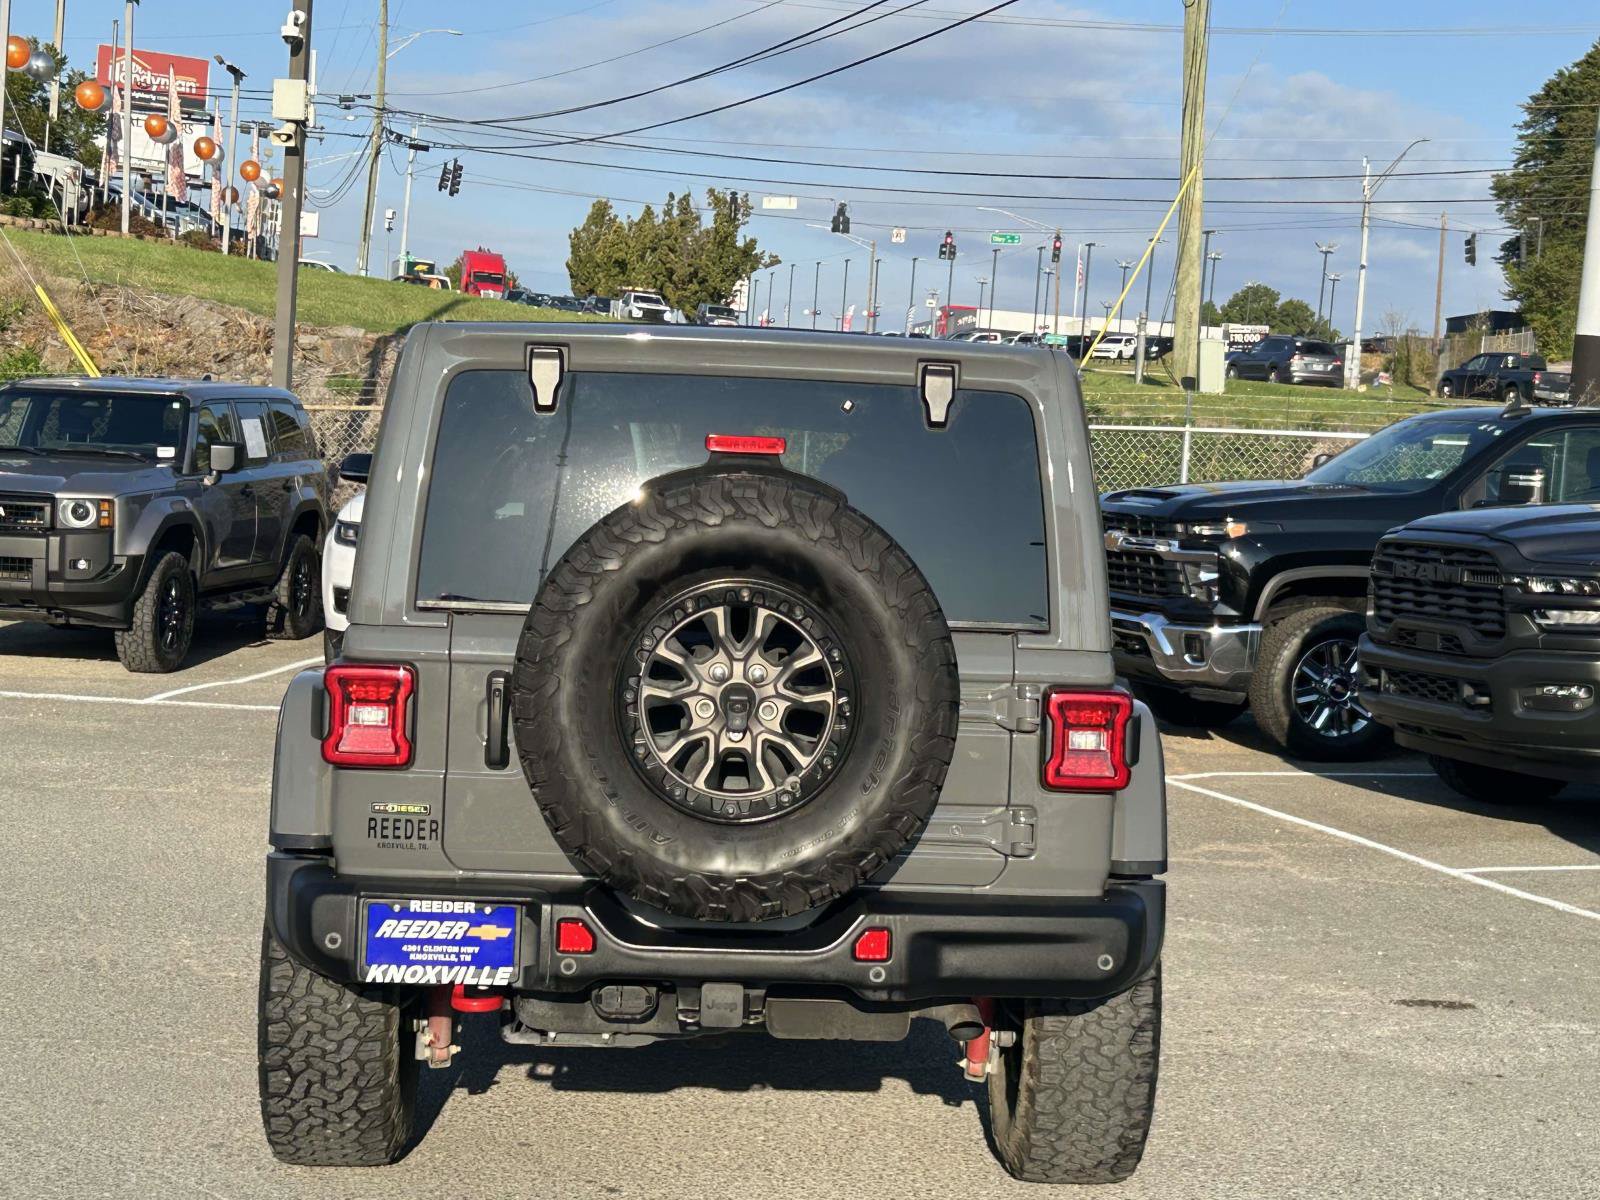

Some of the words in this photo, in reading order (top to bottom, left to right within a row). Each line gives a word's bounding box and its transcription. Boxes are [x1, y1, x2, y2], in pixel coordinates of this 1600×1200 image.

[109, 63, 197, 93] Handyman
[1393, 560, 1460, 583] RAM
[367, 817, 439, 841] REEDER
[409, 899, 476, 914] REEDER
[374, 919, 470, 940] REEDER
[409, 953, 458, 962] KNOXVILLE,
[459, 954, 472, 962] TN
[422, 945, 460, 953] CLINTON
[365, 963, 514, 986] KNOXVILLE
[706, 999, 738, 1013] Jeep
